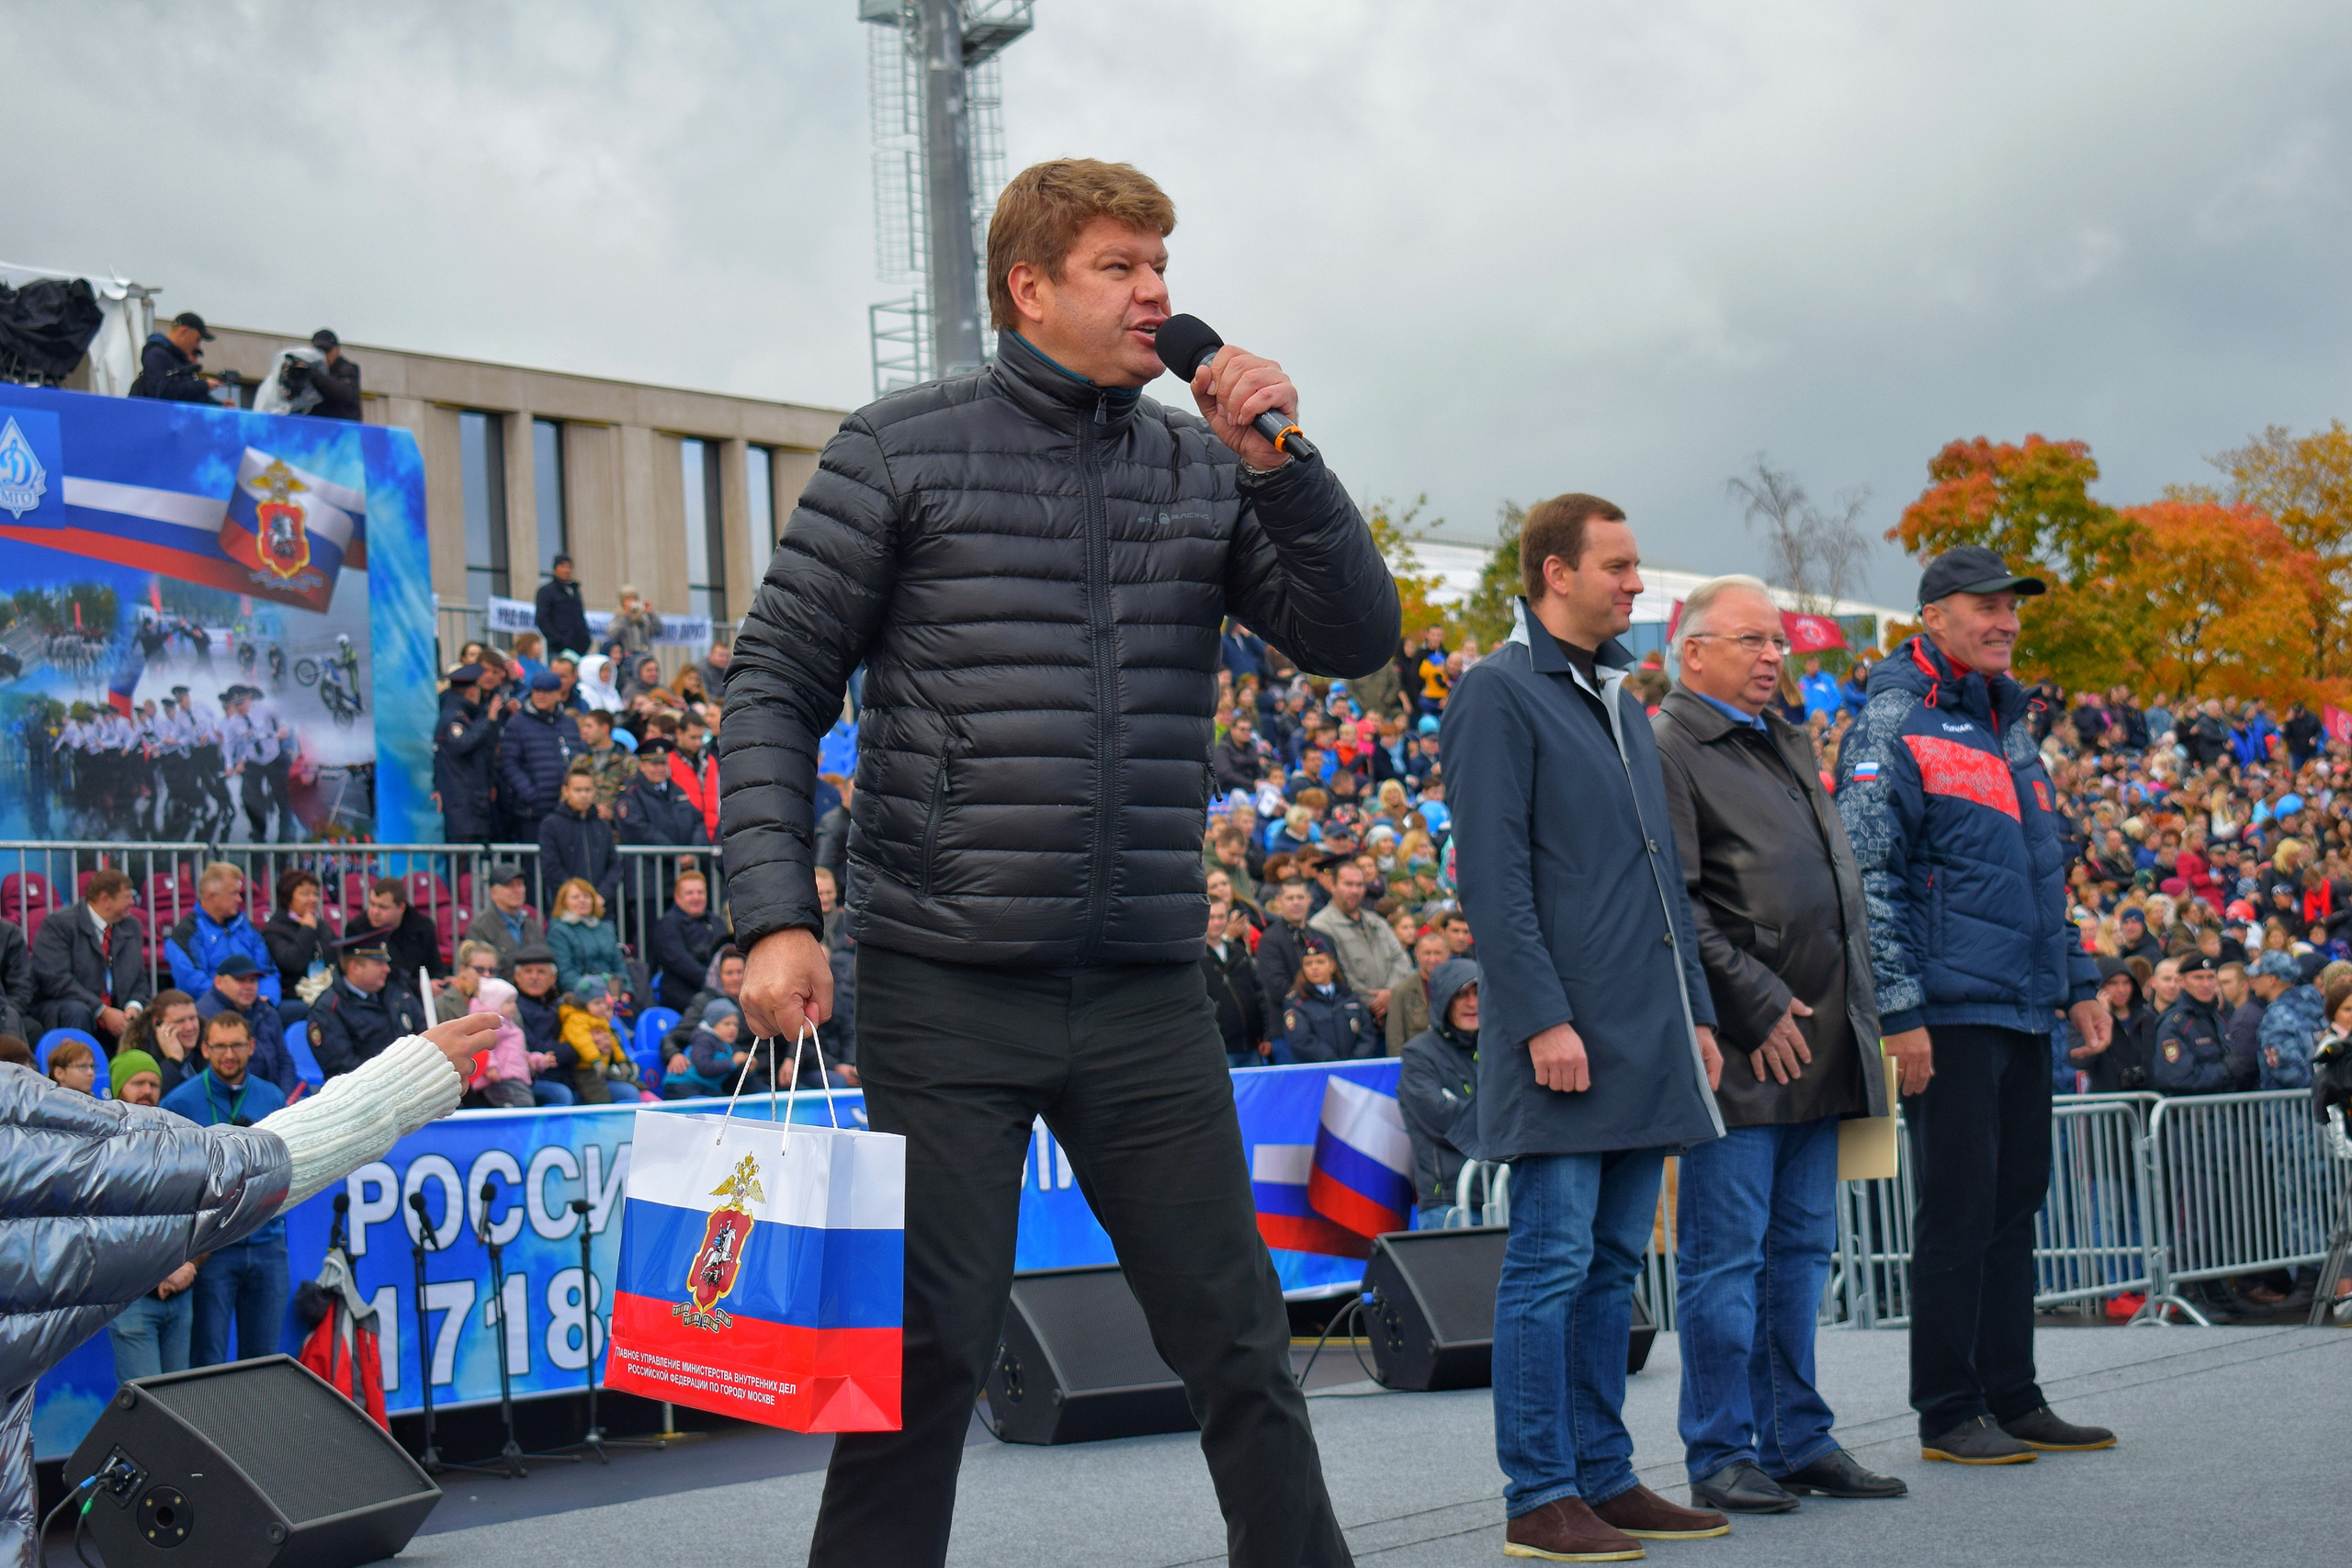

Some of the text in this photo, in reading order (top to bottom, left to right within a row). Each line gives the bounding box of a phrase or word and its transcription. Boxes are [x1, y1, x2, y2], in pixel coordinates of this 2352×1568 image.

[346, 1142, 633, 1255] РОССИ
[368, 1268, 613, 1392] 1718
[616, 1347, 796, 1394] ГЛАВНОЕ УПРАВЛЕНИЕ МИНИСТЕРСТВА ВНУТРЕННИХ ДЕЛ
[628, 1363, 775, 1405] РОССИЙСКОЙ ФЕДЕРАЦИИ ПО ГОРОДУ МОСКВЕ
